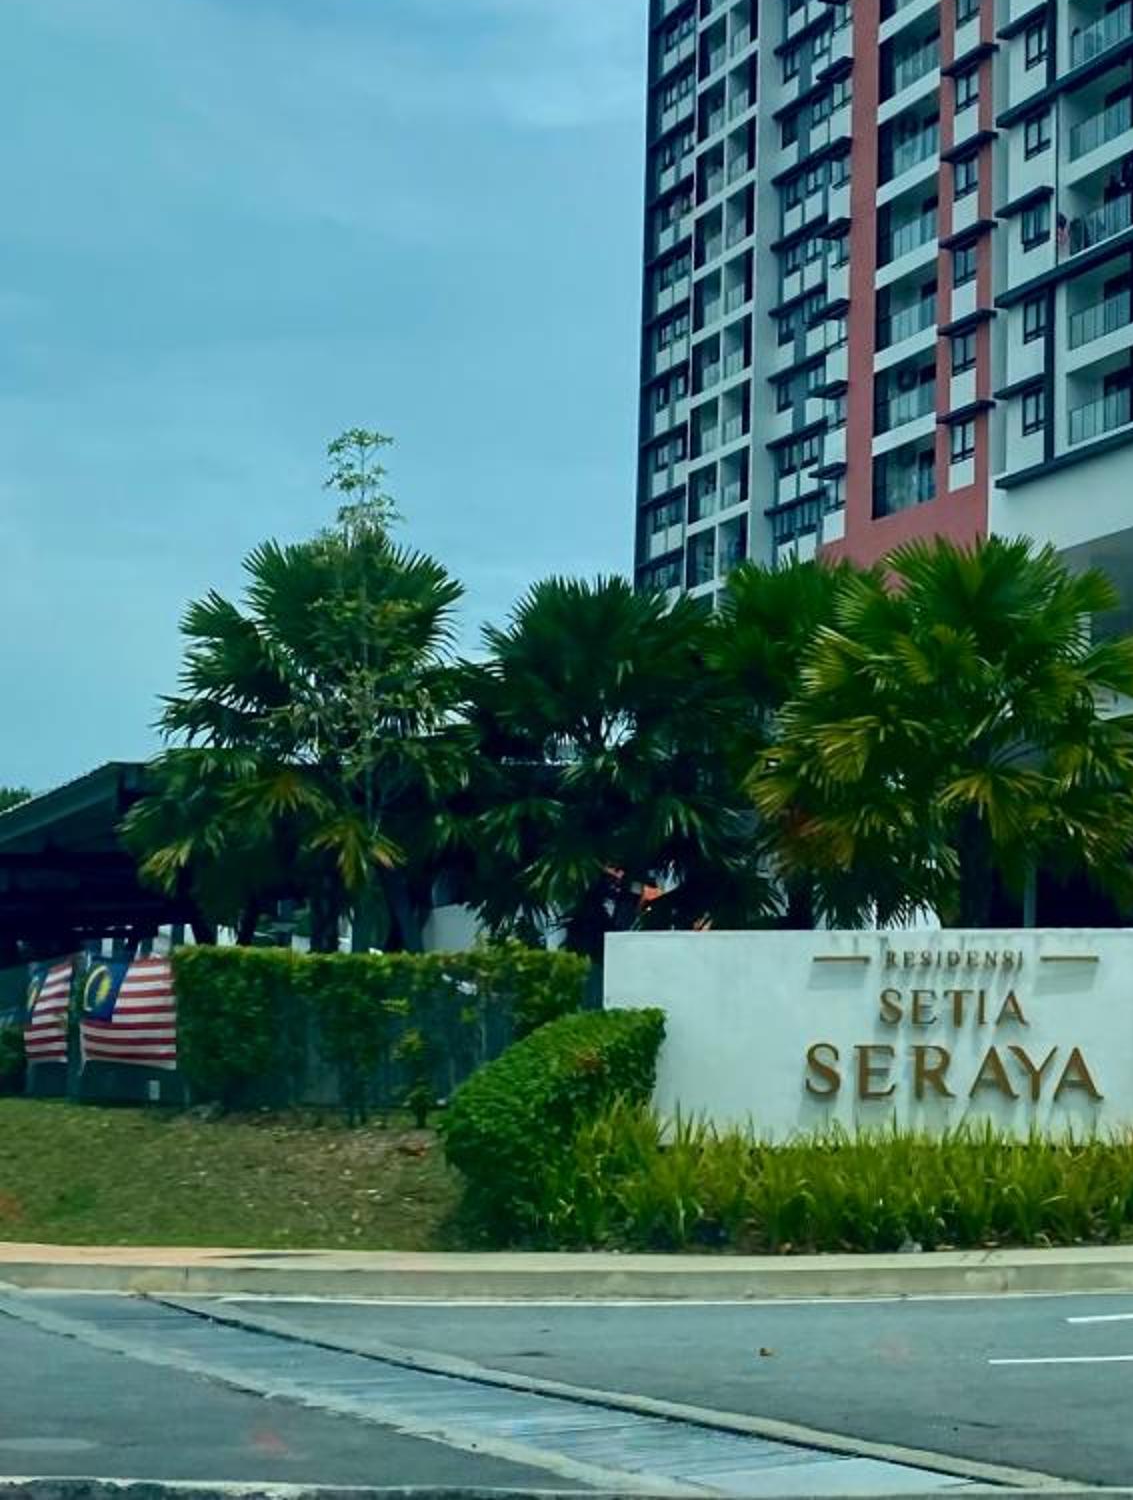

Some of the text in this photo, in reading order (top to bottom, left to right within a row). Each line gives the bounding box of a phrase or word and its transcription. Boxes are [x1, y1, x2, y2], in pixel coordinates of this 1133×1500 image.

[884, 950, 1023, 970] RESIDENSI
[879, 988, 1030, 1028] SETIA
[805, 1043, 1104, 1101] SERAYA
